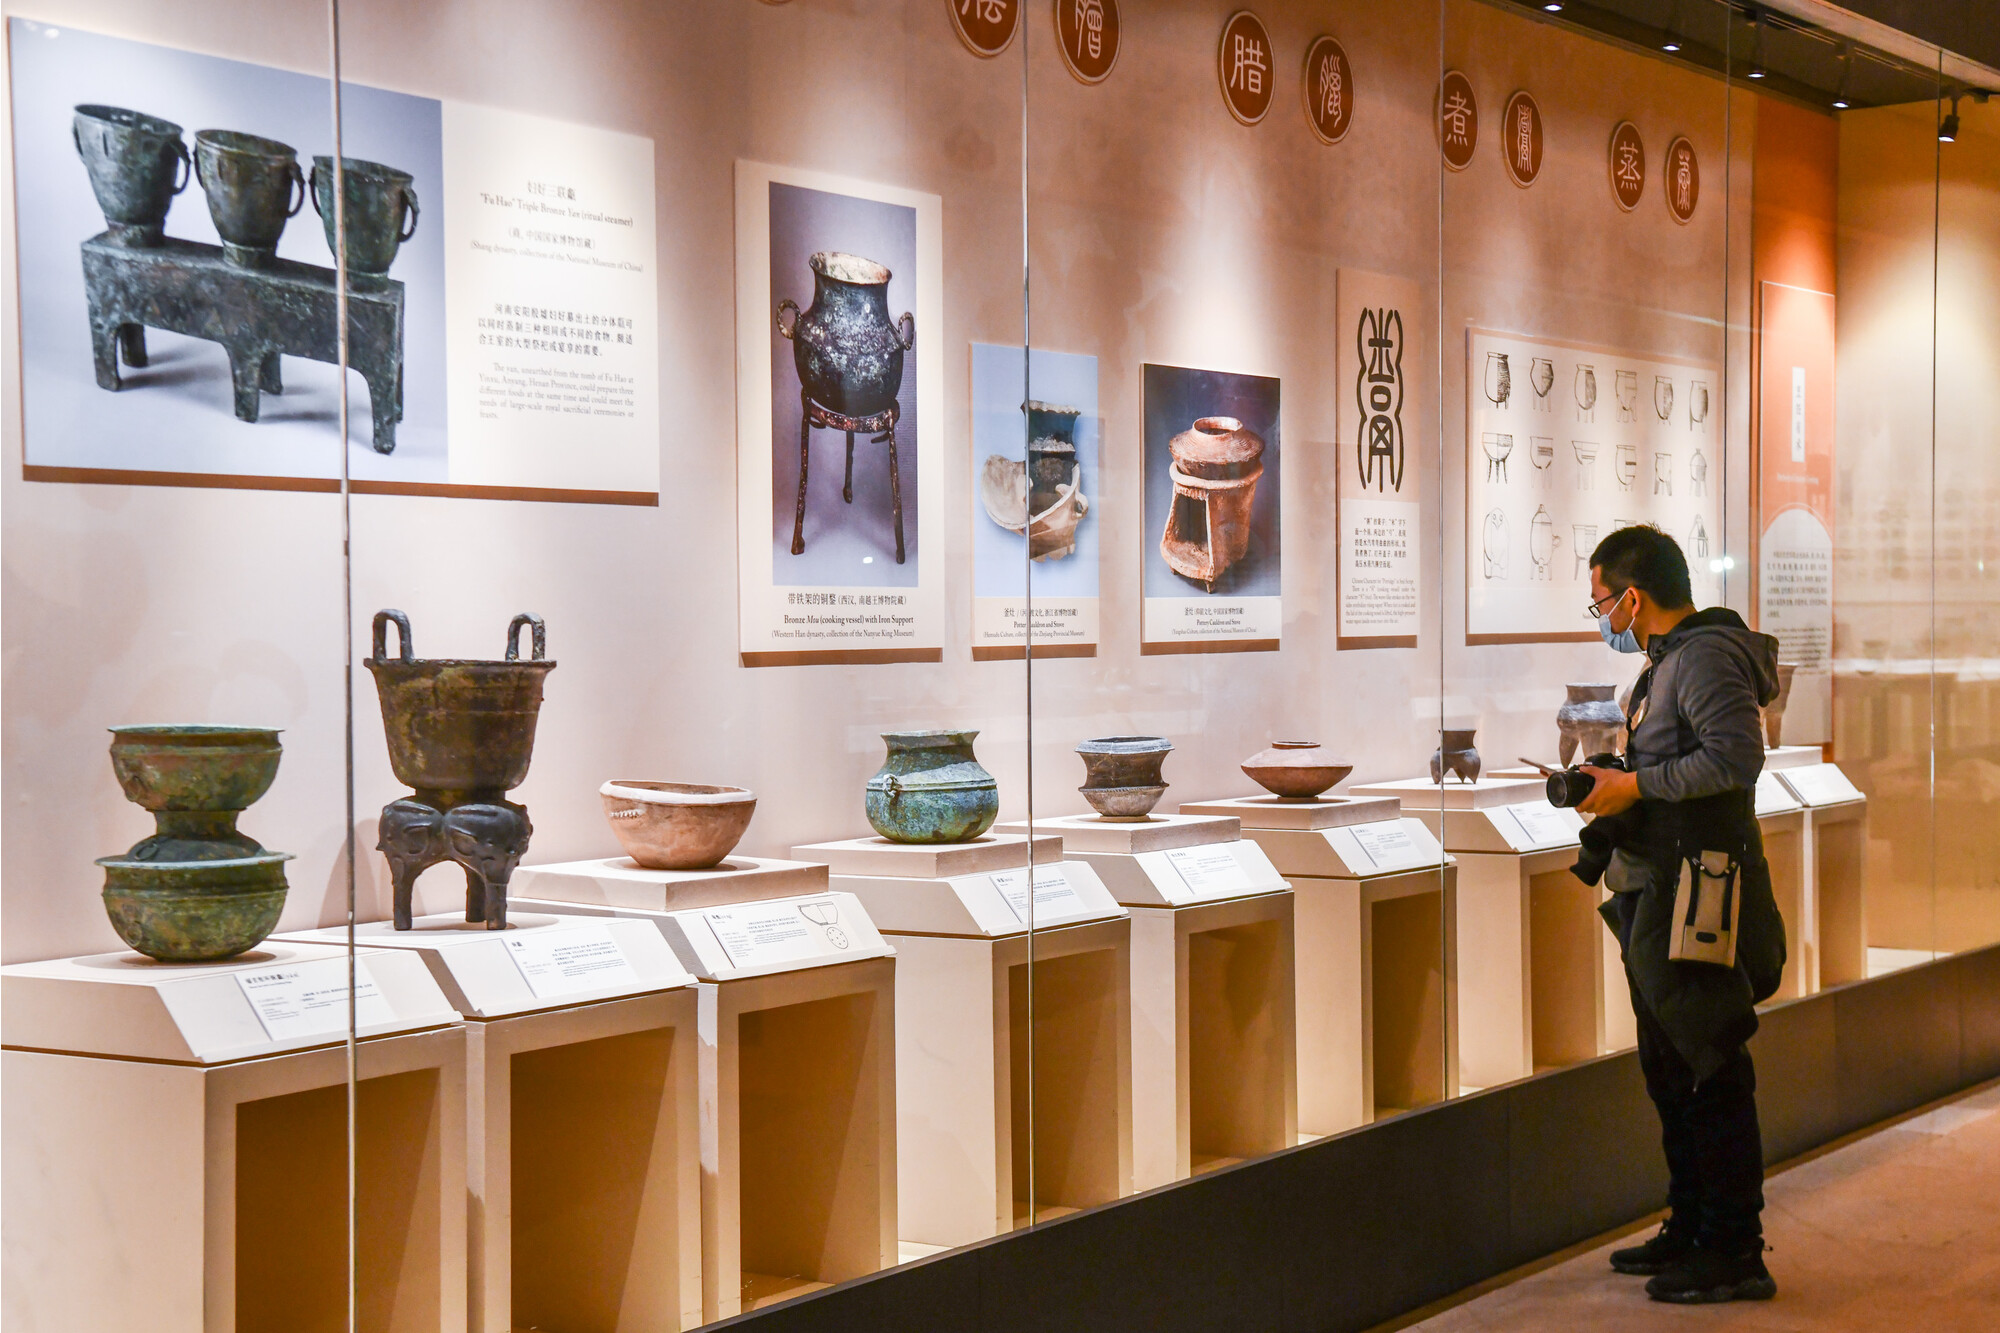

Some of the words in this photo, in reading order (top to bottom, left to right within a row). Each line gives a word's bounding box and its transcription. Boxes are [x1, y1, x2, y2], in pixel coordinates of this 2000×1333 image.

[1231, 35, 1266, 94] 腊
[1443, 91, 1472, 147] 煮
[1617, 142, 1641, 190] 蒸
[517, 199, 538, 214] Triple
[541, 203, 566, 216] Bronze
[582, 210, 603, 222] (ritual
[605, 215, 633, 227] steamer)
[772, 630, 793, 638] (Western
[795, 630, 805, 638] Han
[882, 629, 892, 639] King
[784, 615, 805, 624] Bronze
[820, 615, 845, 626] (cooking
[846, 615, 864, 624] vessel)
[865, 615, 877, 623] with
[878, 615, 890, 623] Iron
[892, 614, 913, 626] Support
[1014, 621, 1027, 629] Potter
